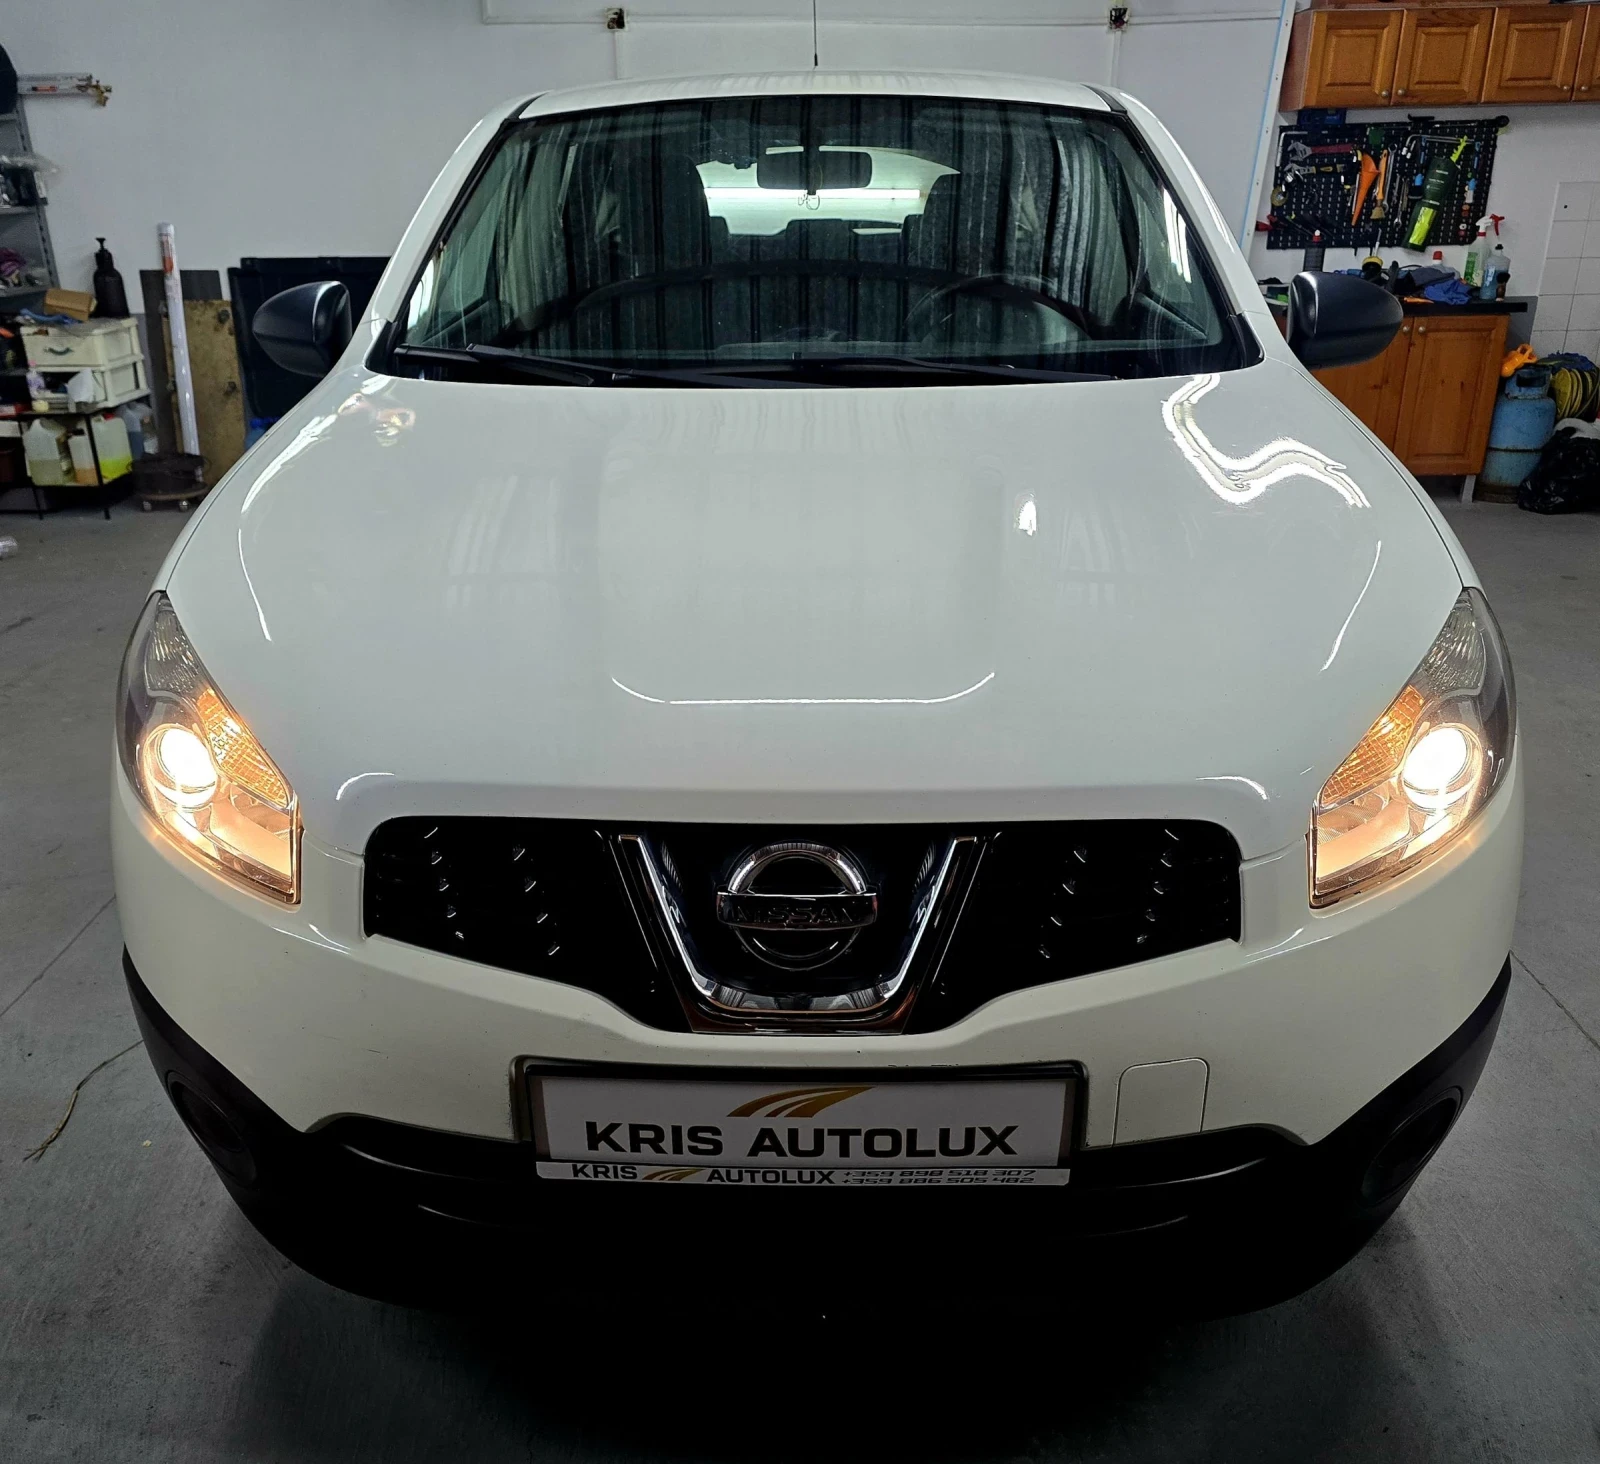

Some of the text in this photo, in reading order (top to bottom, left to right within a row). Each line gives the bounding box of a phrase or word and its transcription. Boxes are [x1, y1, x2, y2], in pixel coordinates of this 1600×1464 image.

[735, 904, 858, 924] NISSAN
[585, 1120, 1019, 1157] KRIS AUTOLUX
[571, 1163, 836, 1185] KRIS AUTOLUX
